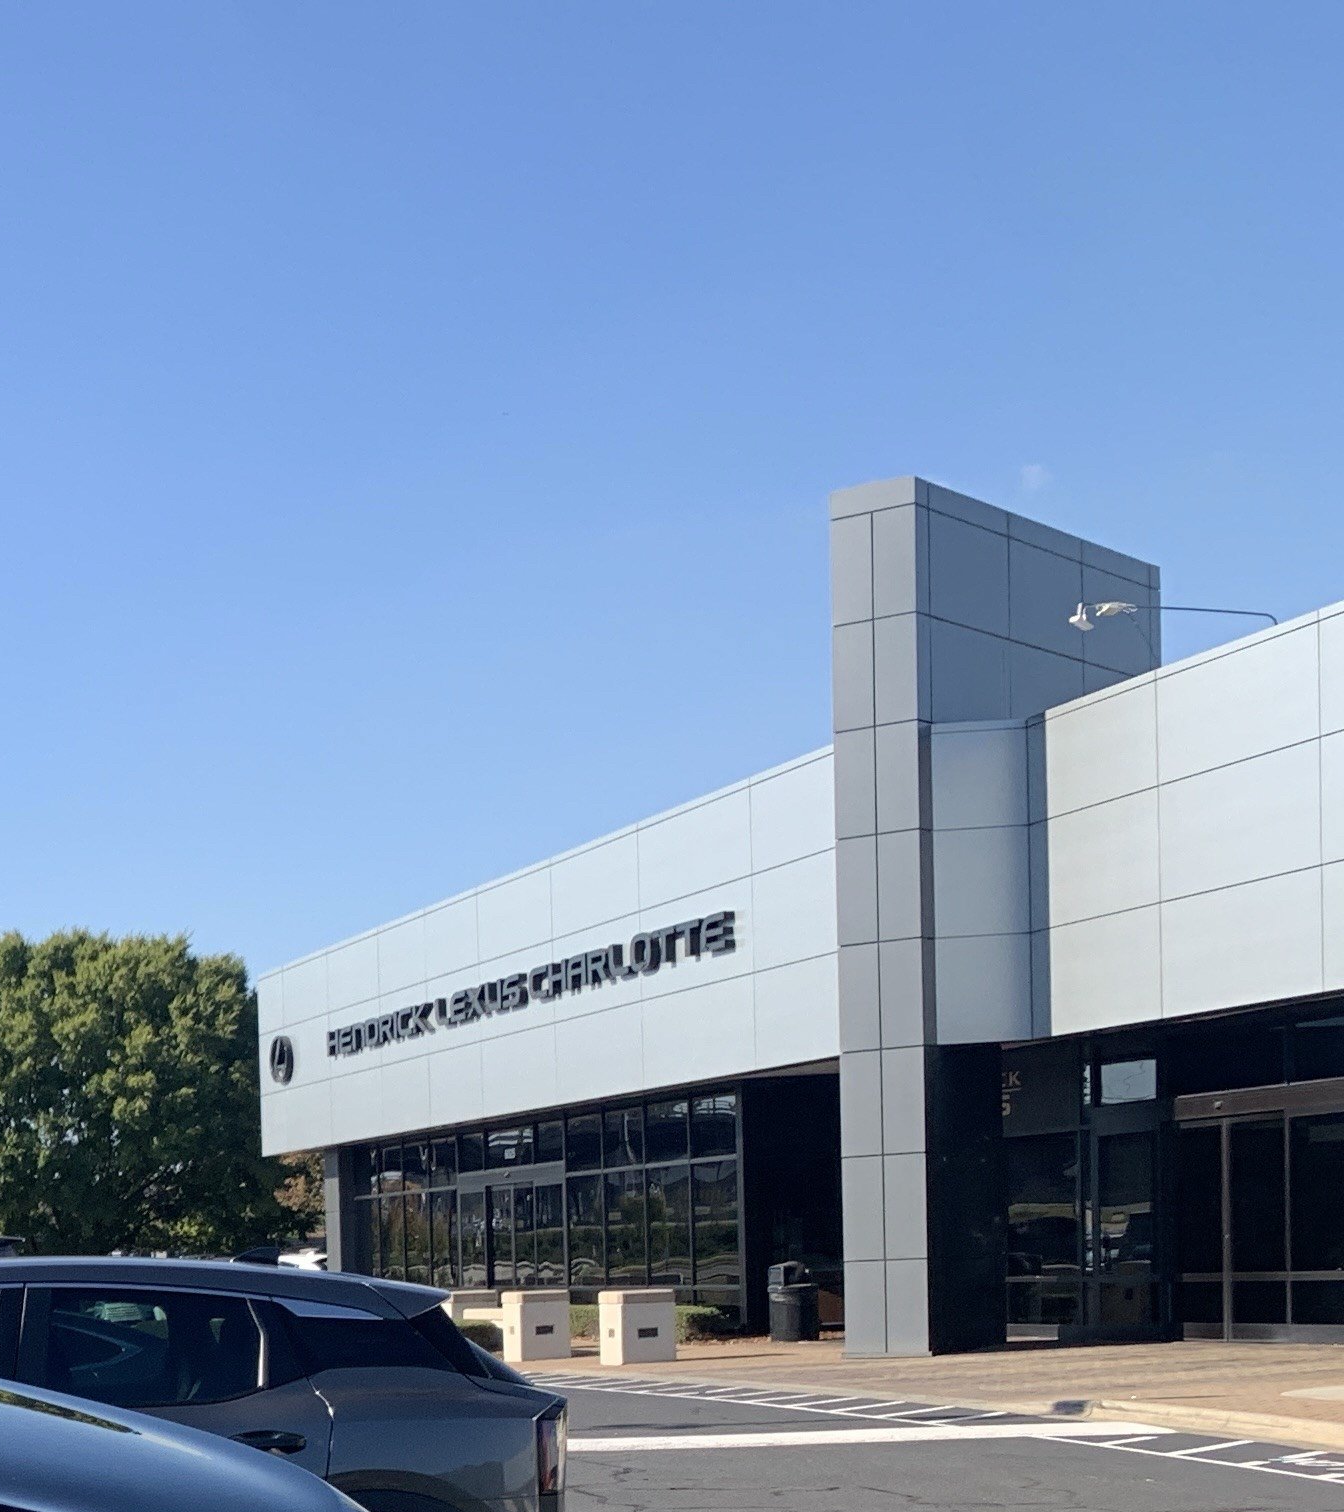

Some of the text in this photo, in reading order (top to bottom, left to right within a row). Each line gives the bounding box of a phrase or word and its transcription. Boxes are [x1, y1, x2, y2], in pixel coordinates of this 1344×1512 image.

[326, 1002, 436, 1060] HENDRICK
[434, 972, 530, 1029] LEXUS
[528, 910, 736, 1005] CHARLOTTE
